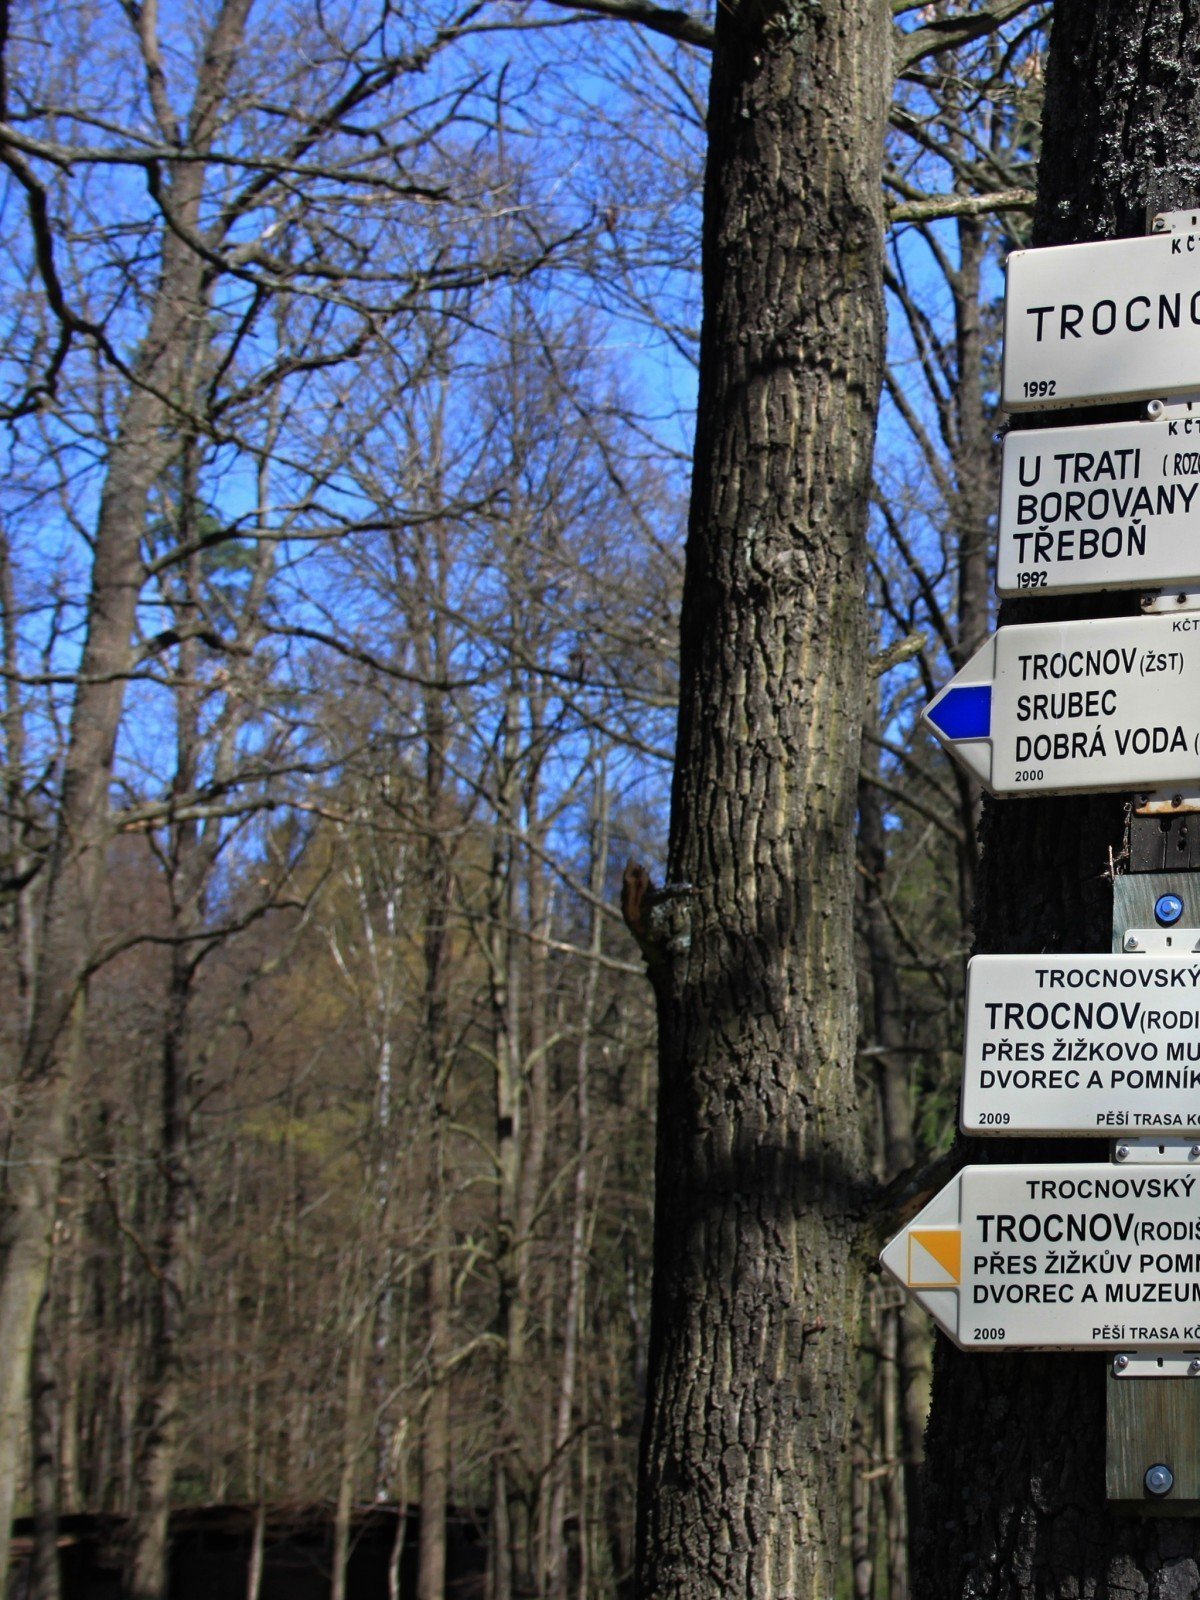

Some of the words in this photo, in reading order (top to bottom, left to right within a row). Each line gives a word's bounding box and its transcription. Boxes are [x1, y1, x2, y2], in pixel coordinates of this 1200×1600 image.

[1023, 380, 1056, 398] 1992
[1018, 456, 1042, 488] U
[1054, 448, 1141, 484] TRATI
[1016, 482, 1199, 526] BOROVANY
[1013, 519, 1147, 564] TŘEBOŇ
[1016, 571, 1048, 588] 1992
[1172, 618, 1200, 633] KČT
[1016, 689, 1117, 722] SRUBEC
[1015, 725, 1107, 763] DOBRÁ
[1114, 725, 1188, 757] VODA
[1014, 769, 1044, 783] 2000
[981, 1037, 1044, 1062] PŘES
[1052, 1037, 1159, 1062] ŽIŽKOVO
[979, 1069, 1080, 1089] DVOREC
[1086, 1069, 1104, 1089] A
[978, 1112, 1011, 1125] 2009
[1096, 1109, 1130, 1125] PĚŠÍ
[1131, 1113, 1185, 1126] TRASA
[1026, 1174, 1195, 1200] TROCNOVSKÝ
[973, 1250, 1037, 1275] PŘES
[1044, 1249, 1131, 1274] ŽIŽKŮV
[973, 1284, 1074, 1305] DVOREC
[1081, 1284, 1099, 1304] A
[973, 1327, 1006, 1341] 2009
[1092, 1323, 1127, 1340] PĚŠÍ
[1128, 1326, 1181, 1340] TRASA
